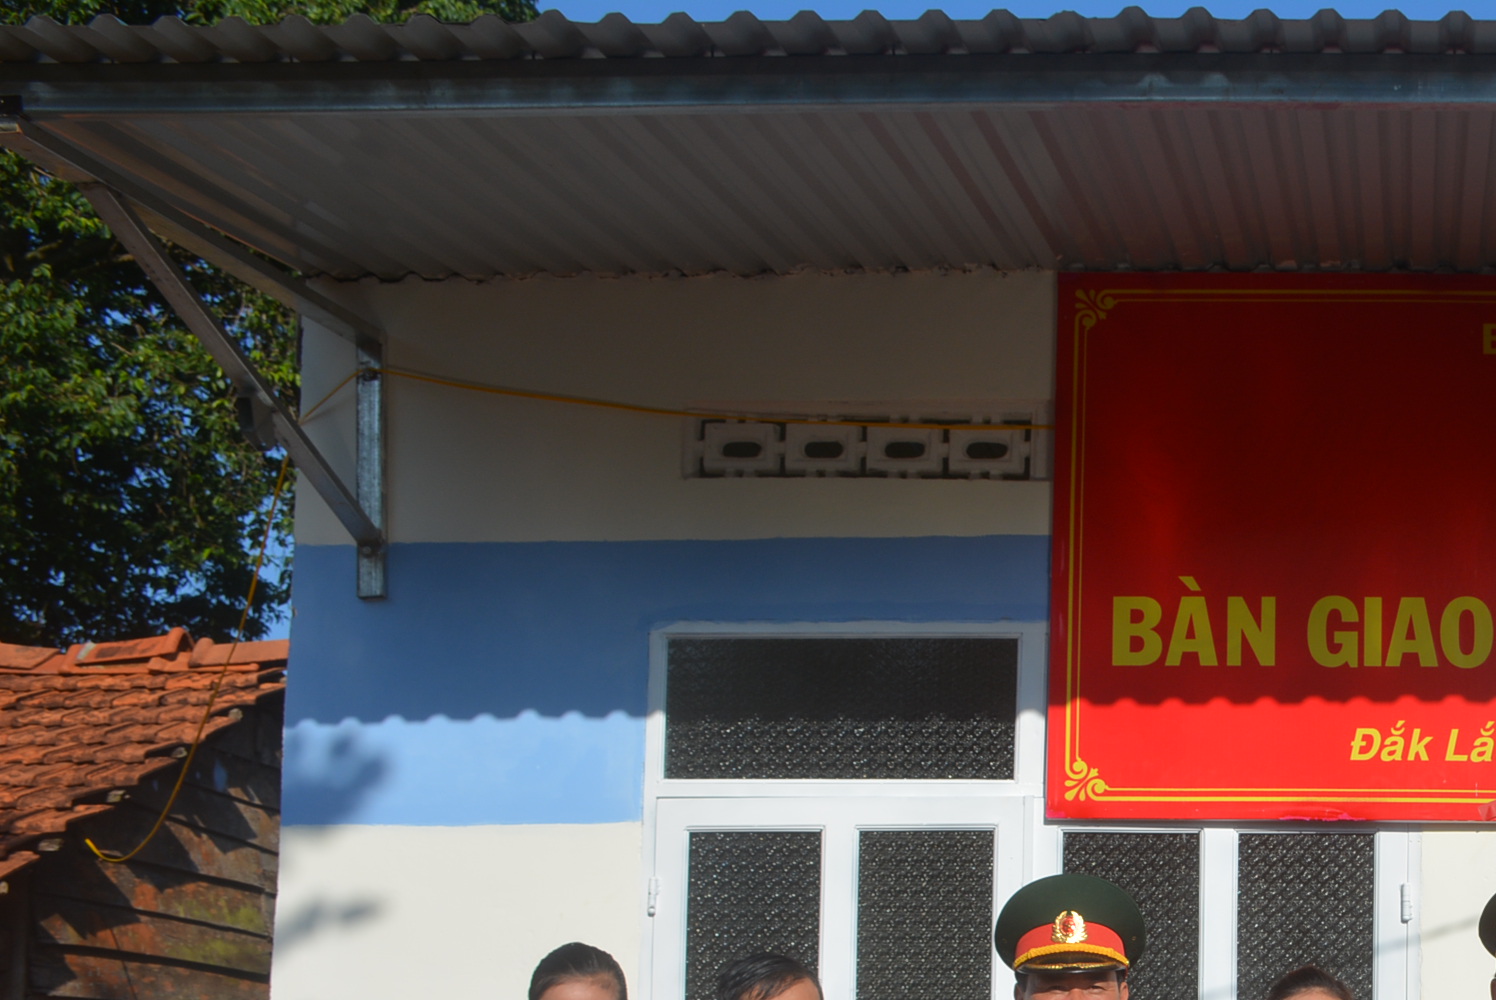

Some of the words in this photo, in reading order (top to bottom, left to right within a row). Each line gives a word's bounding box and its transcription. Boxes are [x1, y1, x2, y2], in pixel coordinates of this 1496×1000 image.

[1111, 576, 1277, 667] BÀN
[1306, 594, 1494, 669] GIAO
[1350, 720, 1434, 762] Đắk
